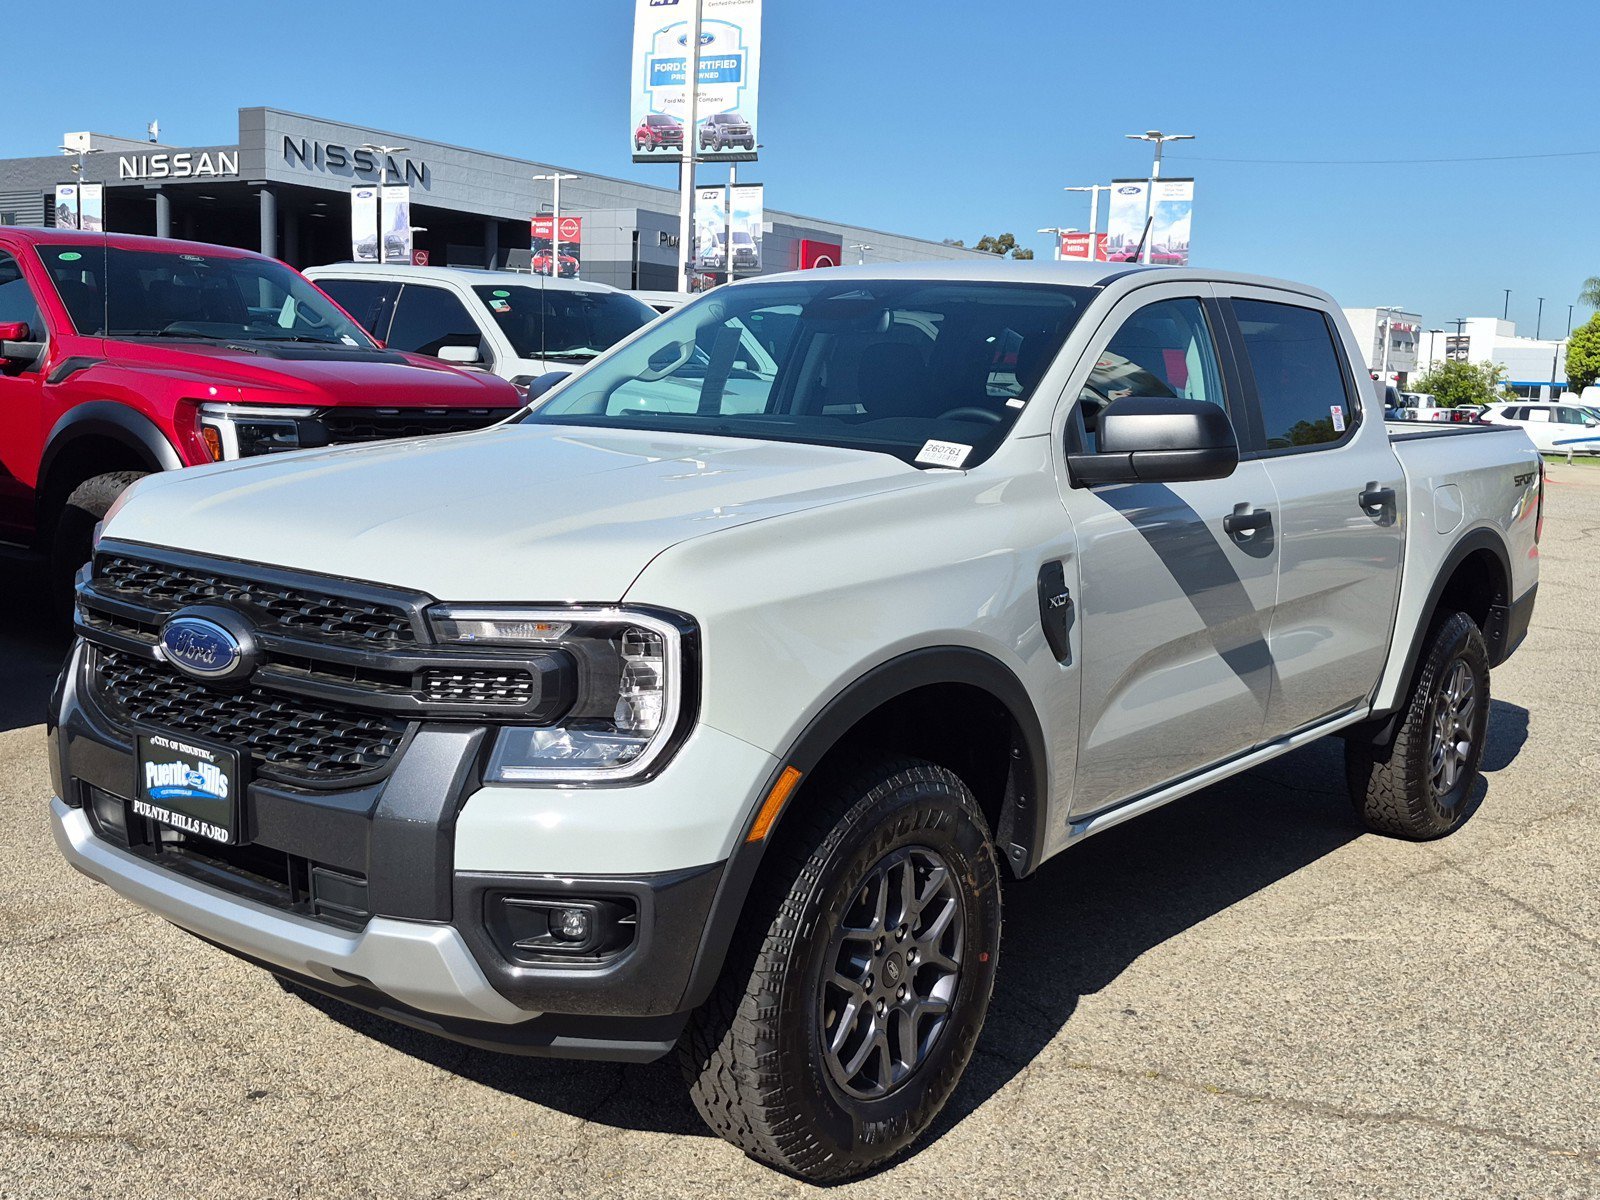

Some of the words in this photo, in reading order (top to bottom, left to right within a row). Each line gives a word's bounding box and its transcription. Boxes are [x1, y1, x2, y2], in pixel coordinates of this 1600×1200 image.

[654, 62, 680, 72] FORD
[682, 60, 737, 71] CRTIFIED
[120, 151, 239, 179] NISSAN
[284, 136, 424, 183] NISSAN
[926, 444, 961, 456] 260761
[1514, 472, 1536, 487] SPORT
[175, 629, 216, 664] Ford
[154, 736, 169, 748] CITY
[170, 741, 179, 750] OF
[179, 743, 211, 759] INDUSTRY
[145, 761, 190, 789] Puente
[198, 761, 228, 798] Hills
[133, 800, 169, 822] PUENTE
[171, 812, 199, 833] HILLS
[201, 822, 228, 842] FORD
